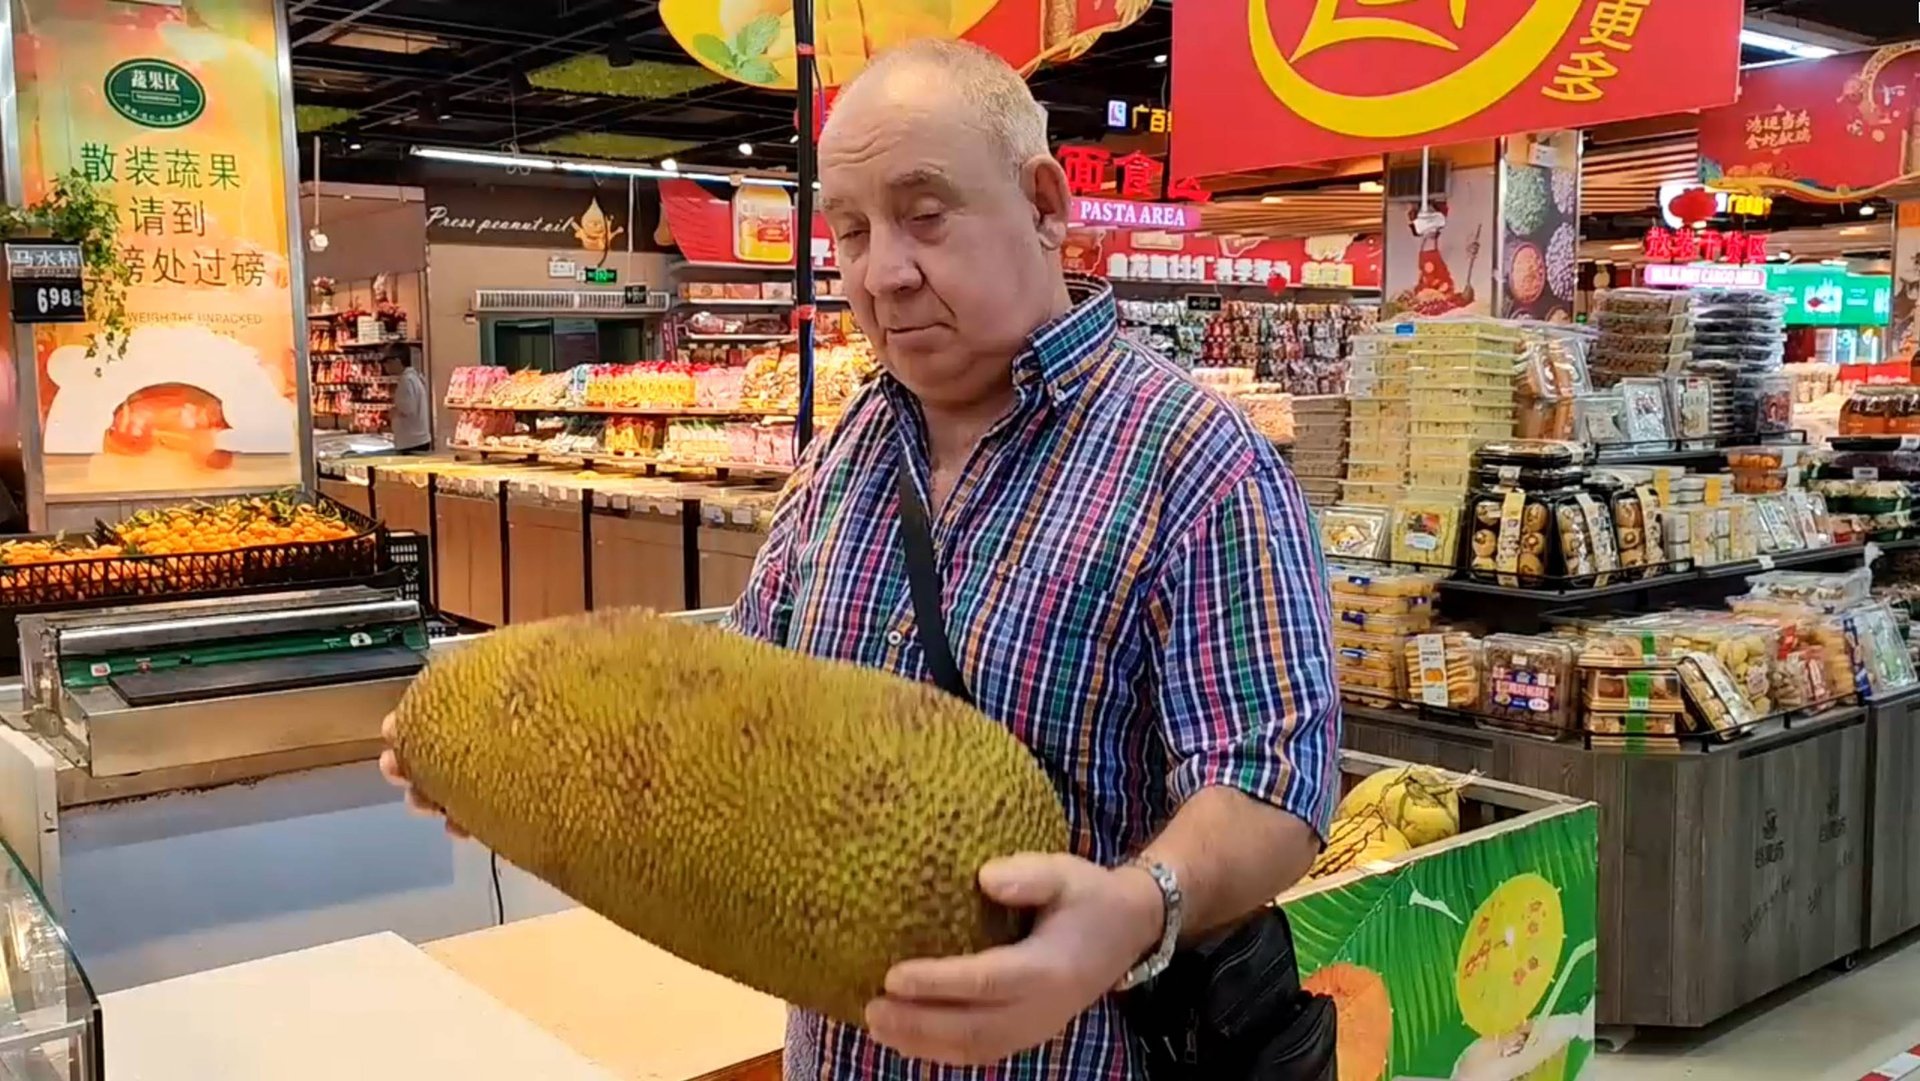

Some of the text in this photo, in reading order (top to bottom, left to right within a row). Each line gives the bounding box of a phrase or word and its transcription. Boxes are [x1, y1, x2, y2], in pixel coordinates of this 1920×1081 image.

[1541, 0, 1652, 101] 更多
[131, 69, 180, 91] 蔬果区
[1132, 104, 1172, 132] 广百
[81, 141, 241, 190] 散装蔬果
[129, 196, 206, 237] 请到
[425, 205, 575, 234] Press peanut oil
[1080, 200, 1185, 226] PASTA AREA
